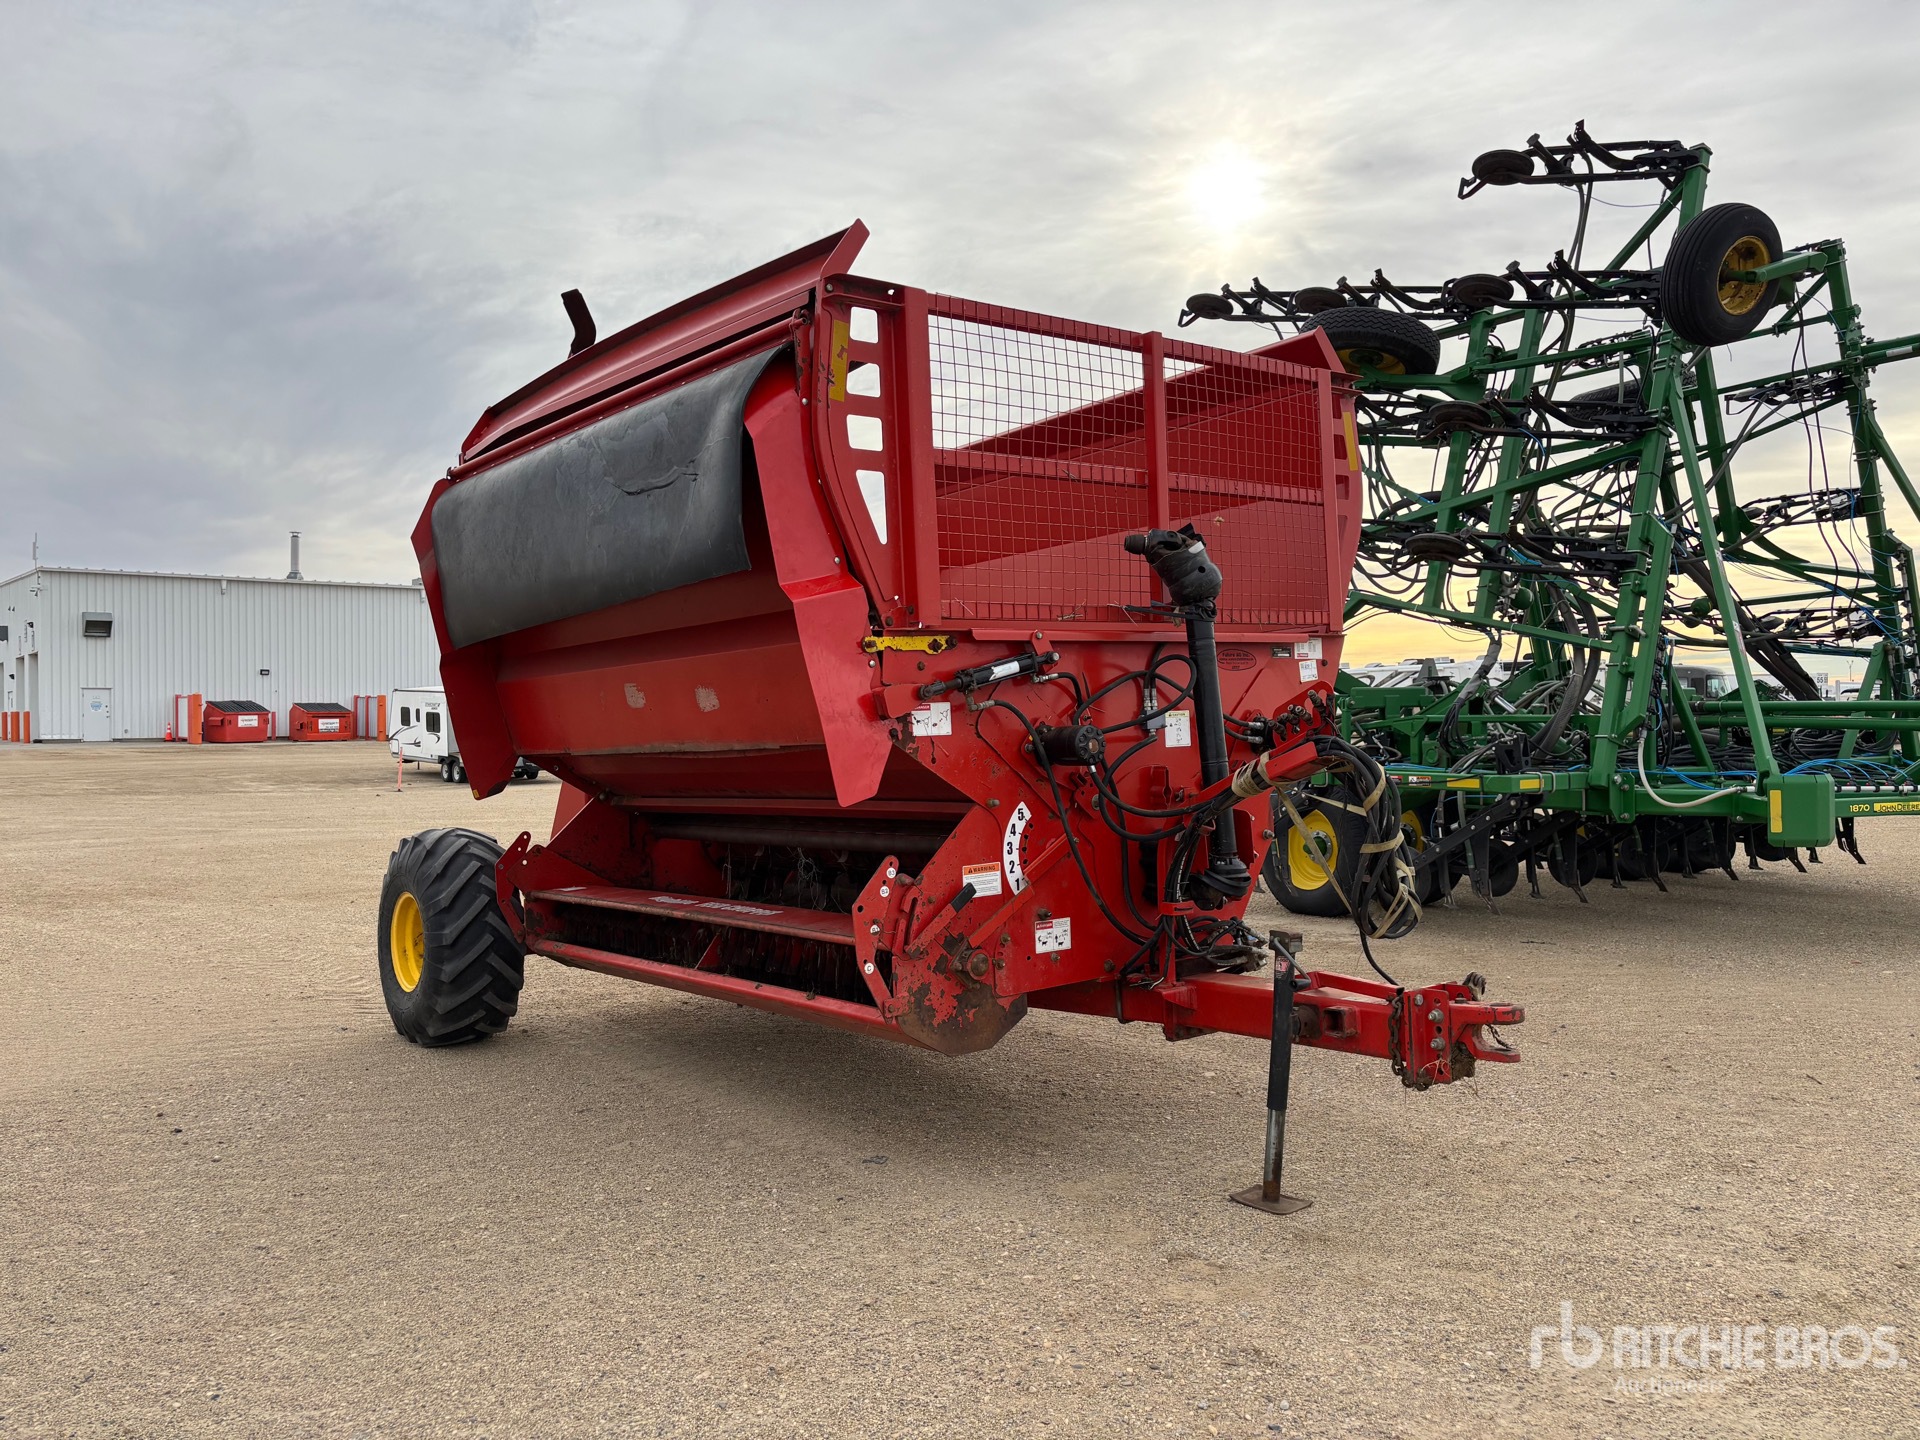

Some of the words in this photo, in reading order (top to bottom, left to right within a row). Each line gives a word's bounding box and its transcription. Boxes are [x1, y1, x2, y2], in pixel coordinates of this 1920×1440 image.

[1018, 808, 1024, 821] 5
[1849, 804, 1870, 812] 1870
[1010, 823, 1016, 836] 4
[1006, 841, 1013, 855] 3
[973, 865, 996, 873] WARNING
[1009, 860, 1015, 874] 2
[1015, 878, 1020, 891] 1
